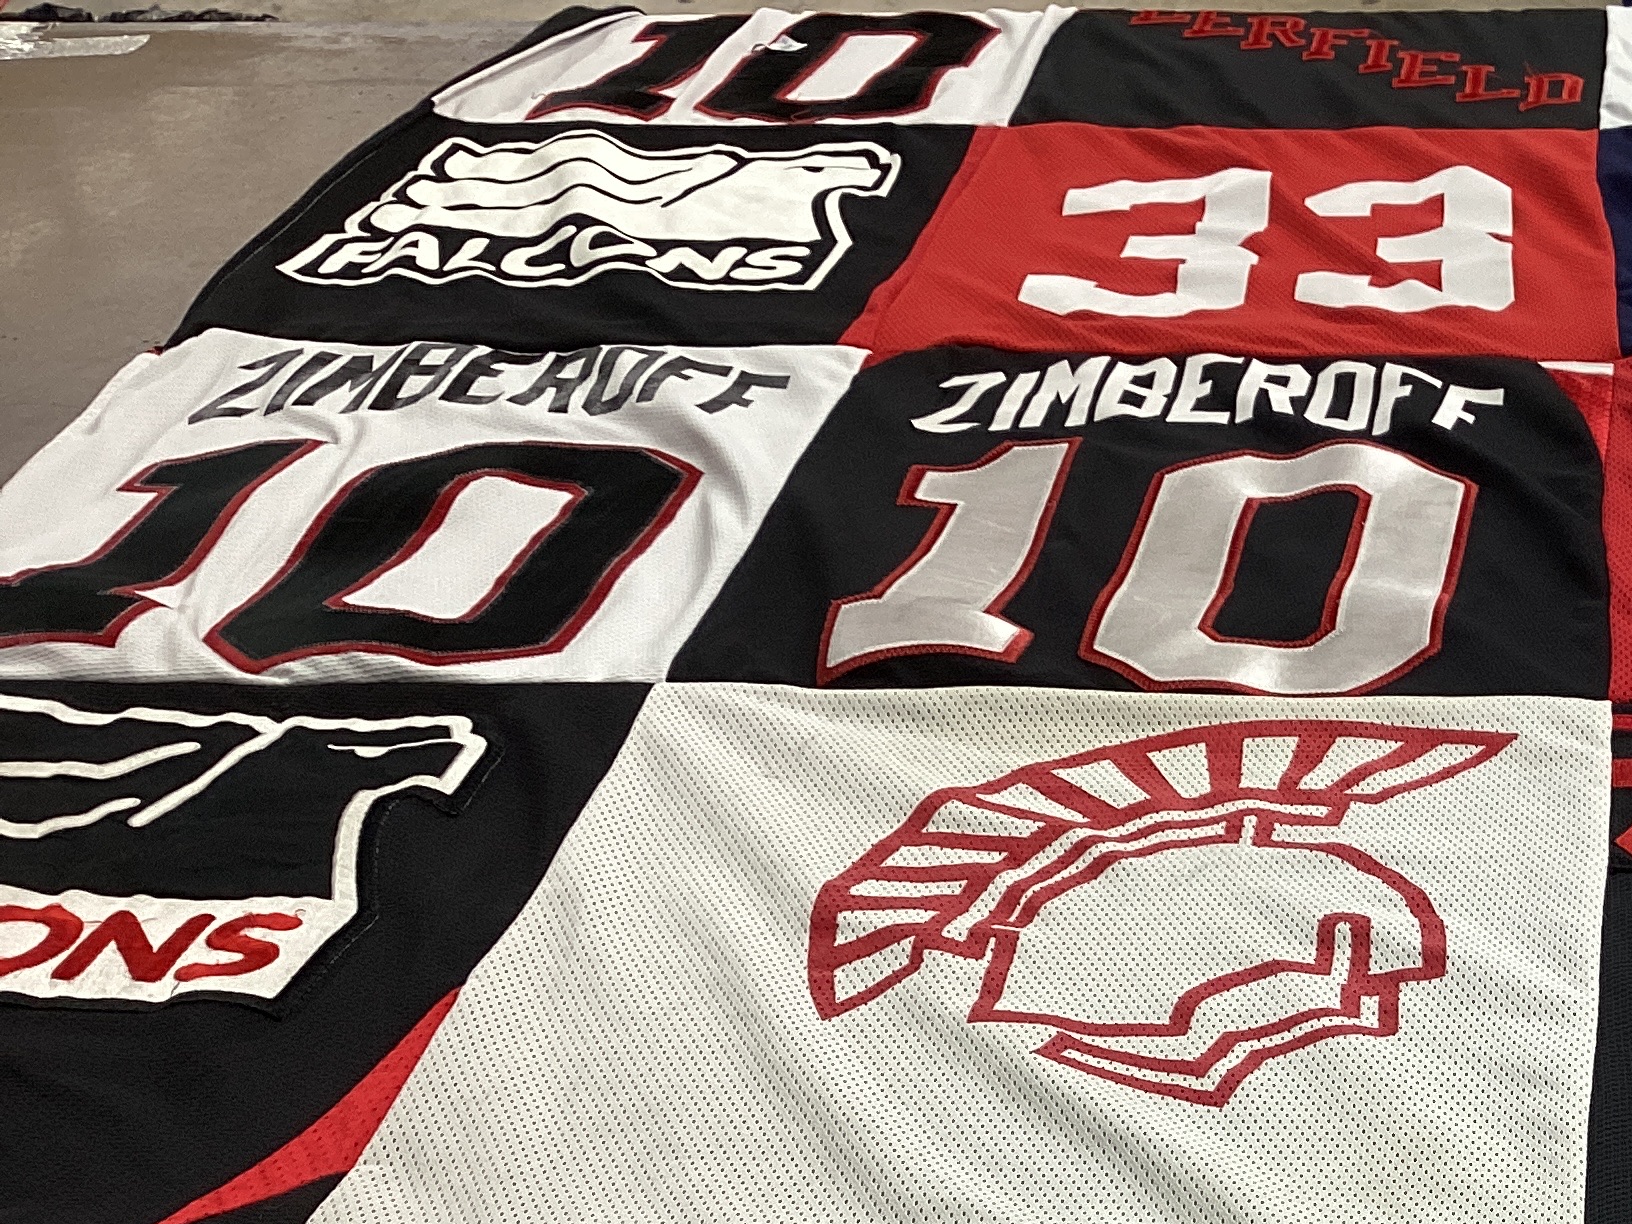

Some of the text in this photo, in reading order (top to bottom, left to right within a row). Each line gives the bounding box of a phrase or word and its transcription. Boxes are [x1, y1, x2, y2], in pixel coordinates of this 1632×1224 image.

[525, 12, 1001, 122] 10
[1129, 10, 1585, 112] ERFIELD
[318, 225, 811, 279] FALCONS
[1018, 166, 1514, 317] 33
[188, 341, 789, 425] ZIMBEROFF
[911, 353, 1504, 435] ZIMBEROFF
[817, 437, 1478, 697] 10
